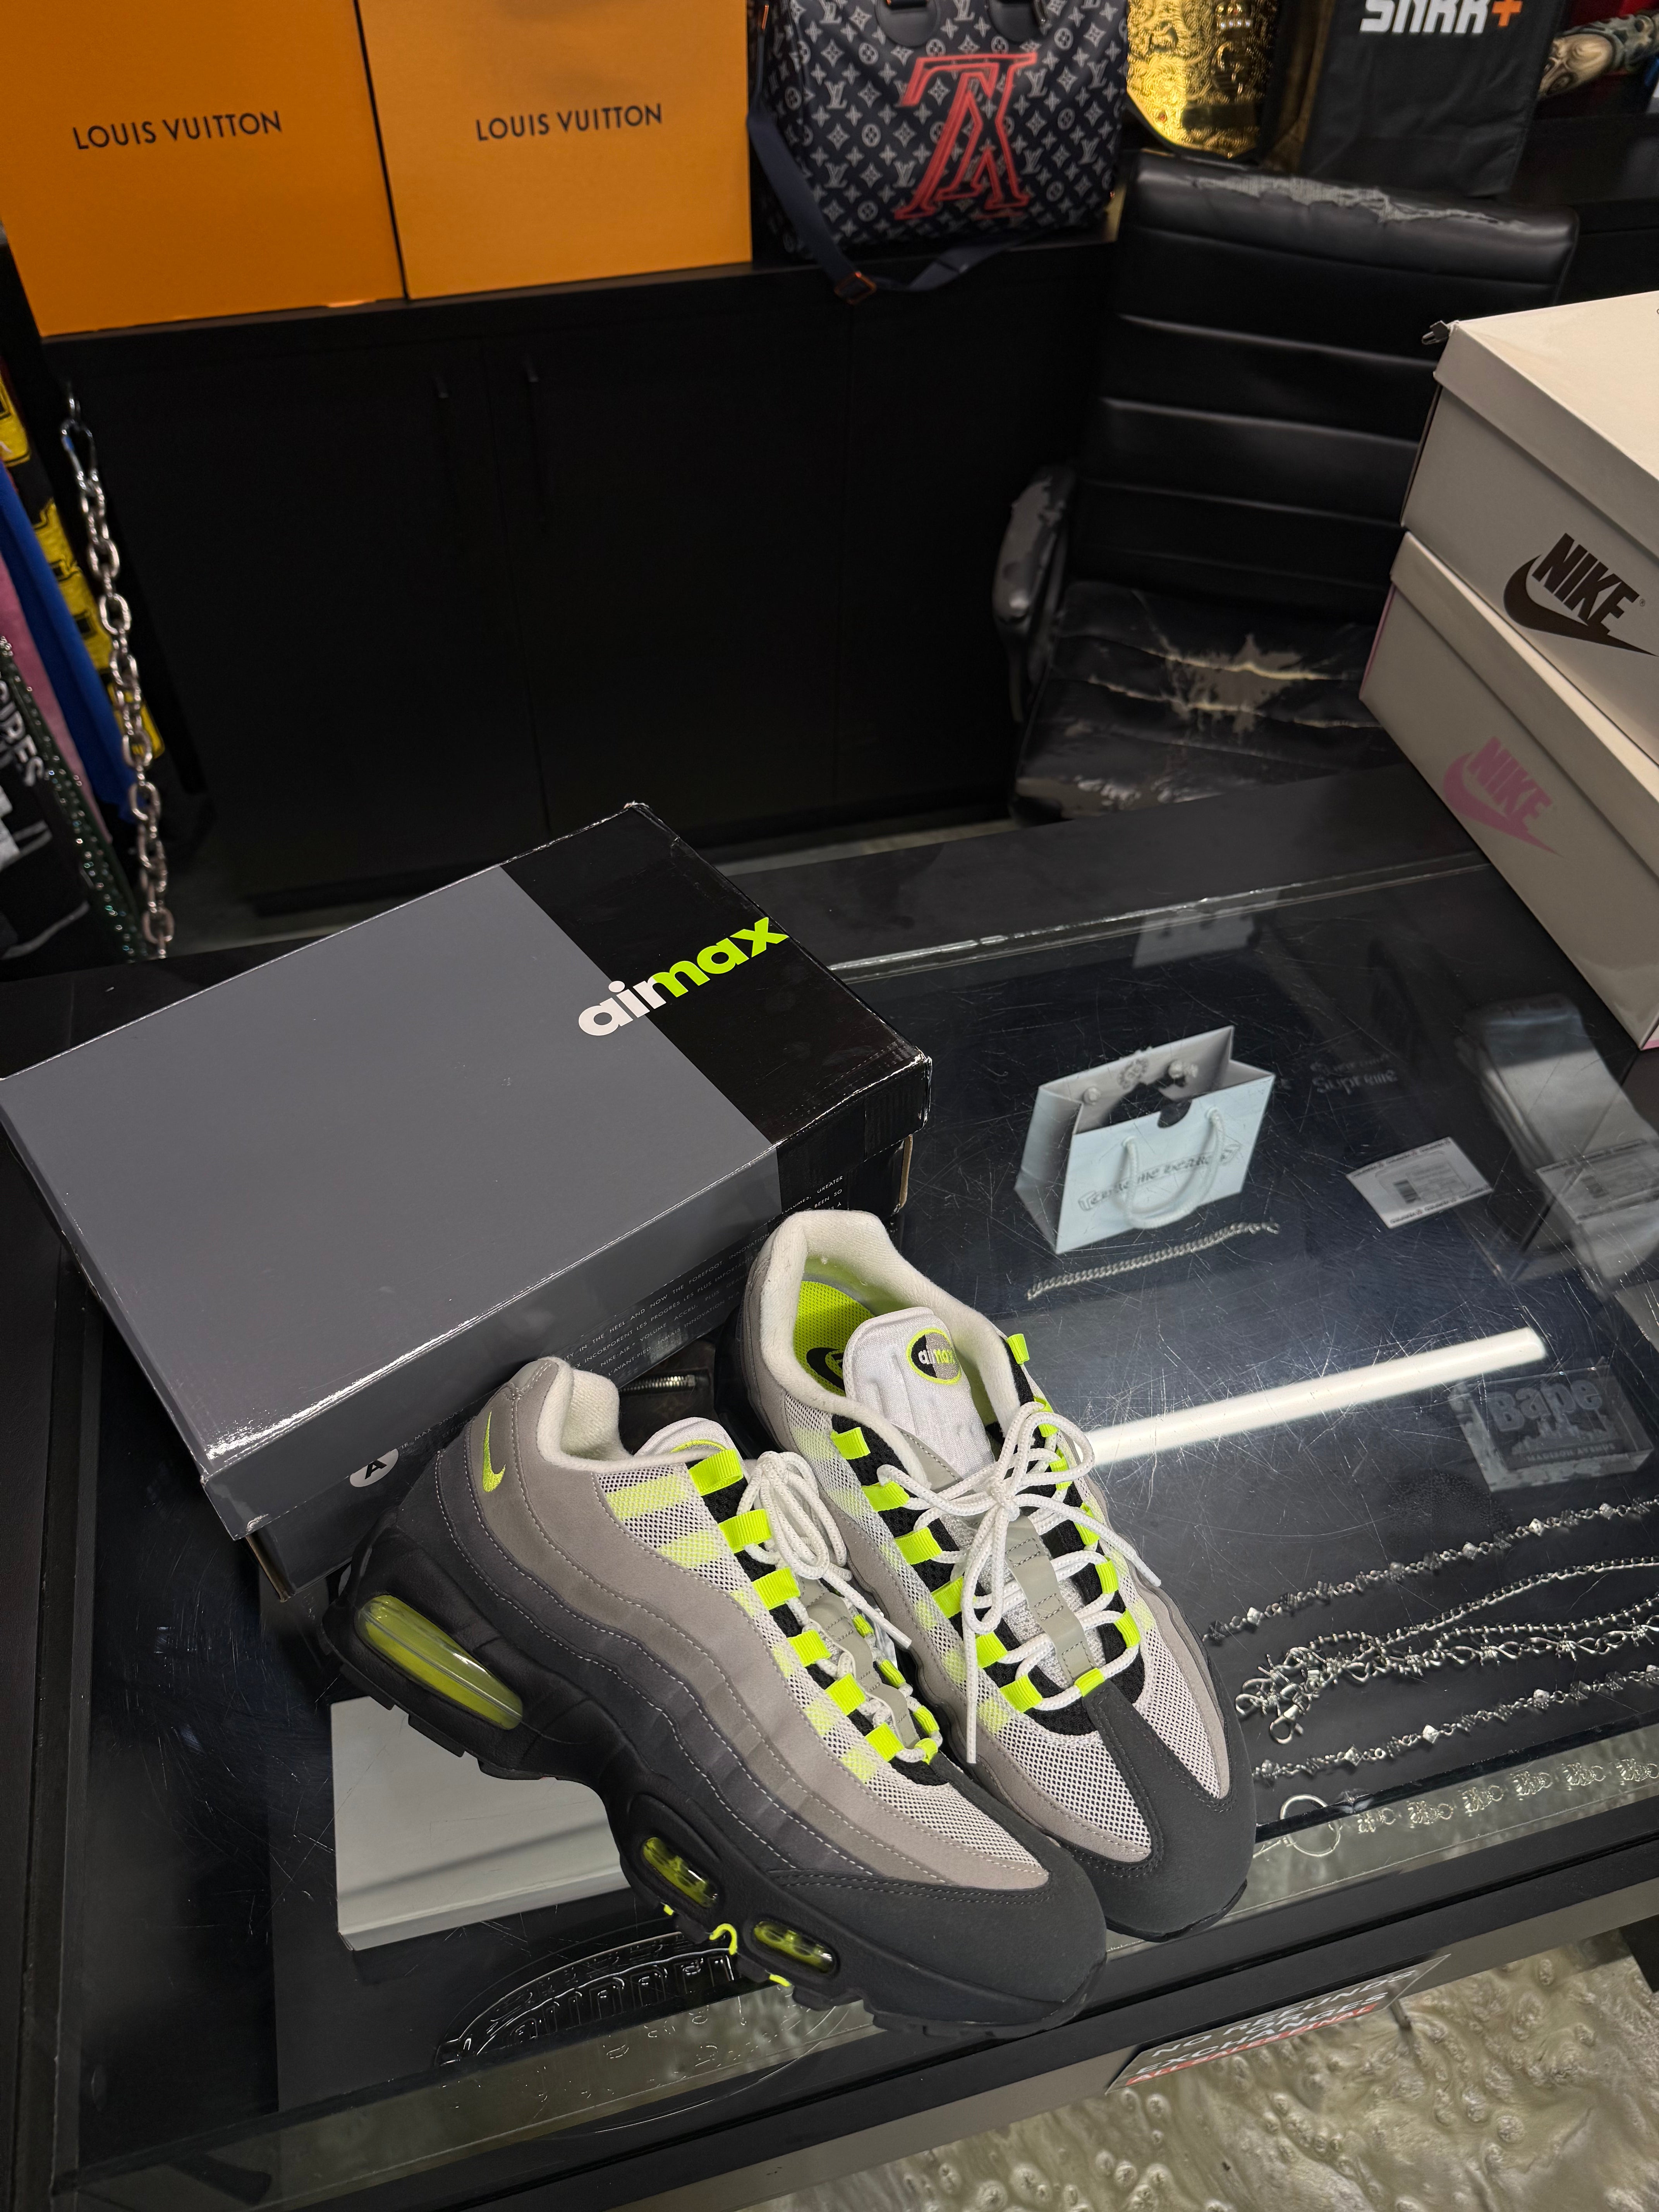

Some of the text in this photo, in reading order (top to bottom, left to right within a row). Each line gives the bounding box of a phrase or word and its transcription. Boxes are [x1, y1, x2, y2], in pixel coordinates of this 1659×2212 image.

[72, 110, 282, 150] LOUIS VUITTON
[476, 103, 663, 142] LOUIS VUITTON
[1532, 533, 1640, 635] NIKE
[1467, 737, 1553, 835] NIKE
[578, 917, 790, 1036] airmax
[564, 1352, 574, 1360] ITY
[593, 1334, 605, 1343] THE
[610, 1321, 625, 1333] HEEL
[630, 1309, 645, 1321] AND
[651, 1295, 667, 1308] NOW
[672, 1284, 684, 1294] THE
[729, 1233, 769, 1259] INNOVATION
[814, 1196, 829, 1208] BEEN
[585, 1330, 633, 1363] INCORPORENT
[637, 1321, 647, 1330] LES
[684, 1292, 694, 1301] LES
[697, 1281, 712, 1292] PLUS
[640, 1322, 666, 1341] VOLUME
[705, 1290, 719, 1301] PLUS
[658, 1327, 680, 1344] JAMAIS
[684, 1300, 725, 1328] INNOVATION
[415, 1428, 432, 1441] MAX
[1487, 1379, 1602, 1432] Bape
[365, 1459, 387, 1480] A
[1133, 2004, 1372, 2082] ALL SALES FINAL
[1136, 1992, 1389, 2075] EXCHANGES
[1152, 1970, 1416, 2057] NO REFUNDS
[1246, 2013, 1304, 2034] OR
